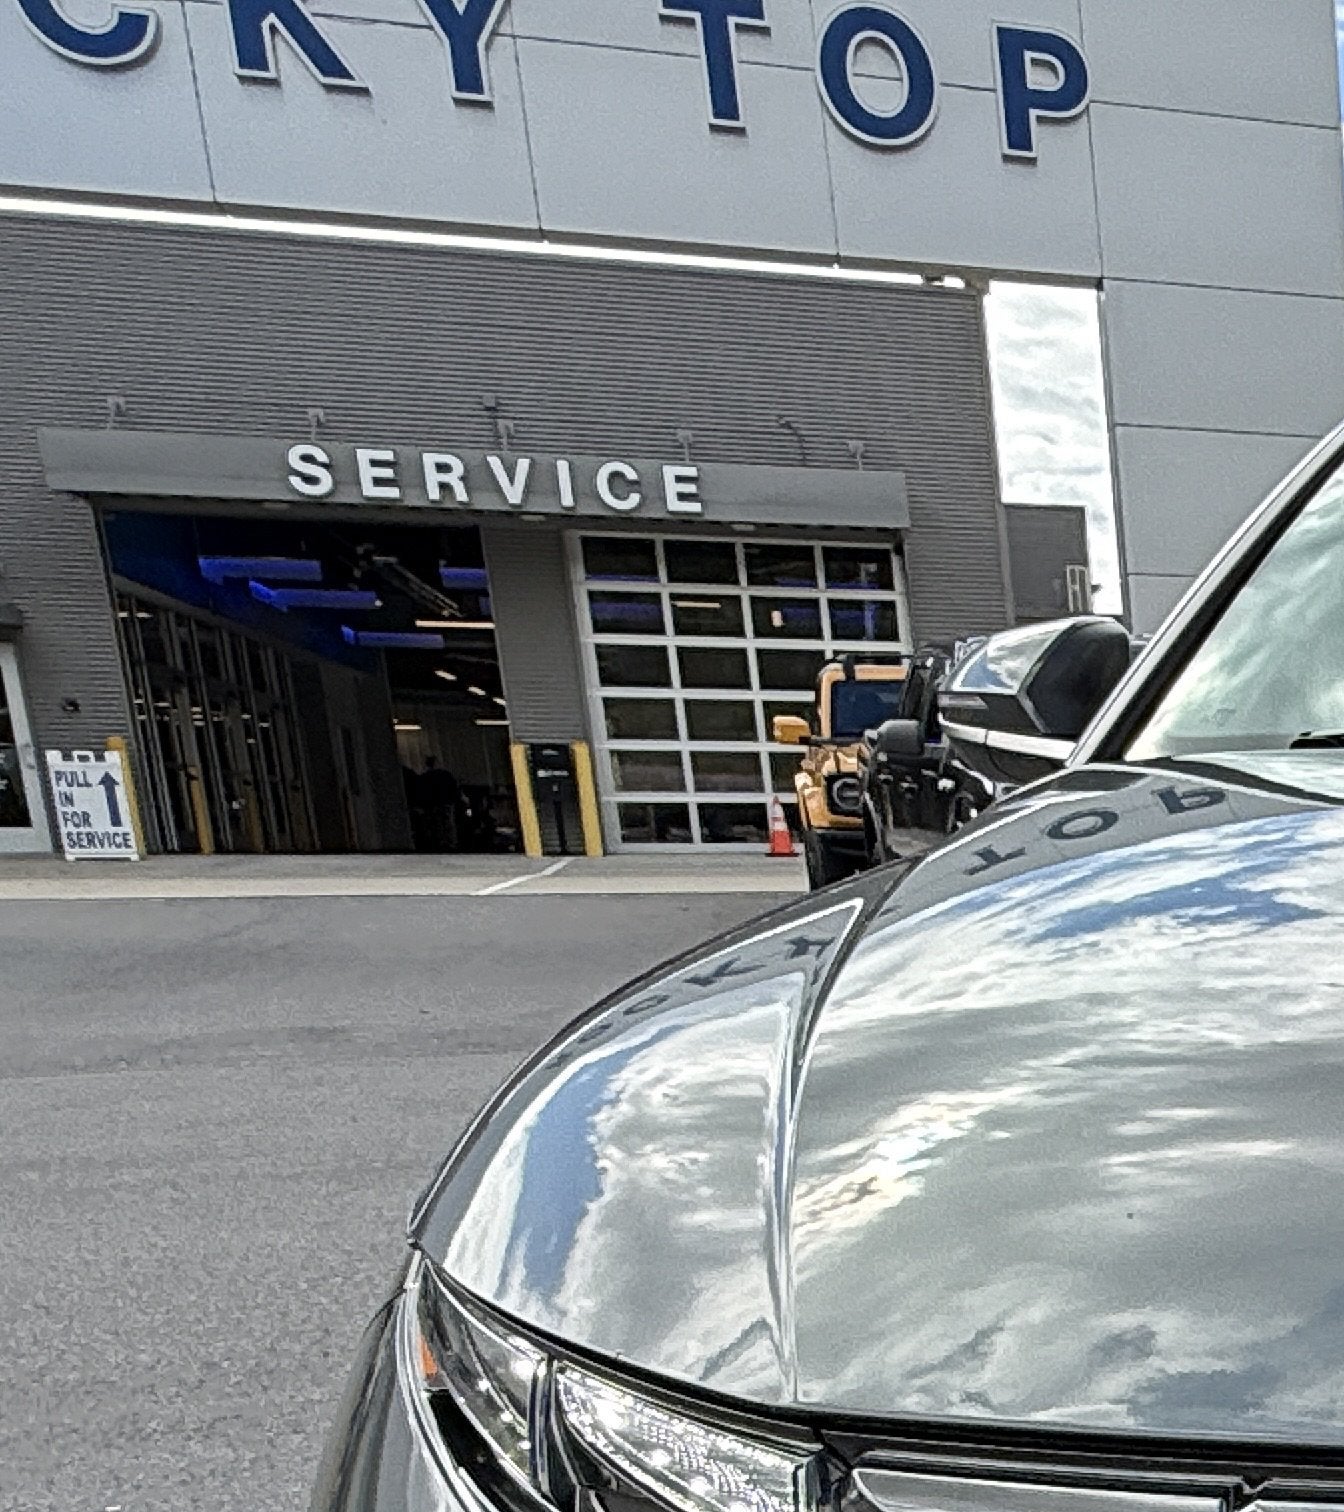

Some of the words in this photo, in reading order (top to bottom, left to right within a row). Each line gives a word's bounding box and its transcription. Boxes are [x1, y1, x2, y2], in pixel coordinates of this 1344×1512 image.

[658, 0, 1089, 157] TOP
[287, 443, 703, 513] SERVICE
[54, 770, 93, 788] PULL
[58, 790, 75, 808] IN
[61, 810, 92, 828] FOR
[65, 830, 134, 849] SERVICE
